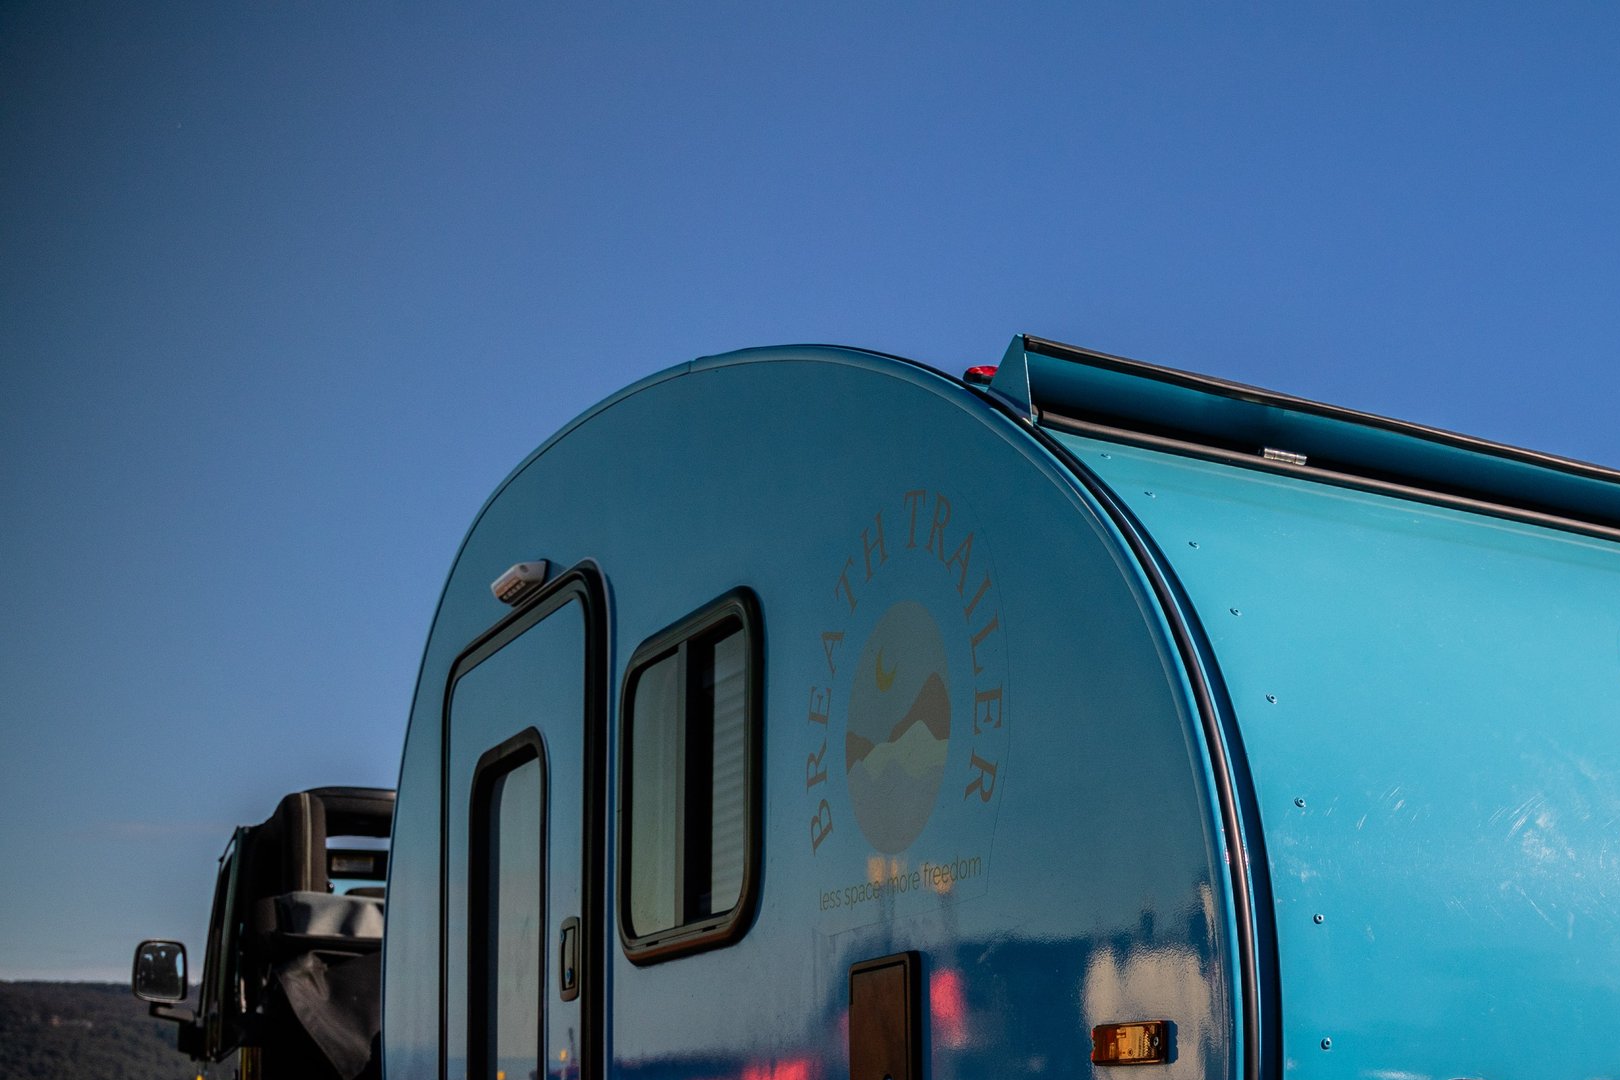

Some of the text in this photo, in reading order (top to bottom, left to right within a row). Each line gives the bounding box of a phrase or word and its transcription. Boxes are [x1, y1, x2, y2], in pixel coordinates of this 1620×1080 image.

[806, 488, 1002, 856] BREATH TRAILER
[819, 888, 842, 911] less
[886, 870, 921, 897] more
[923, 855, 982, 888] freedom
